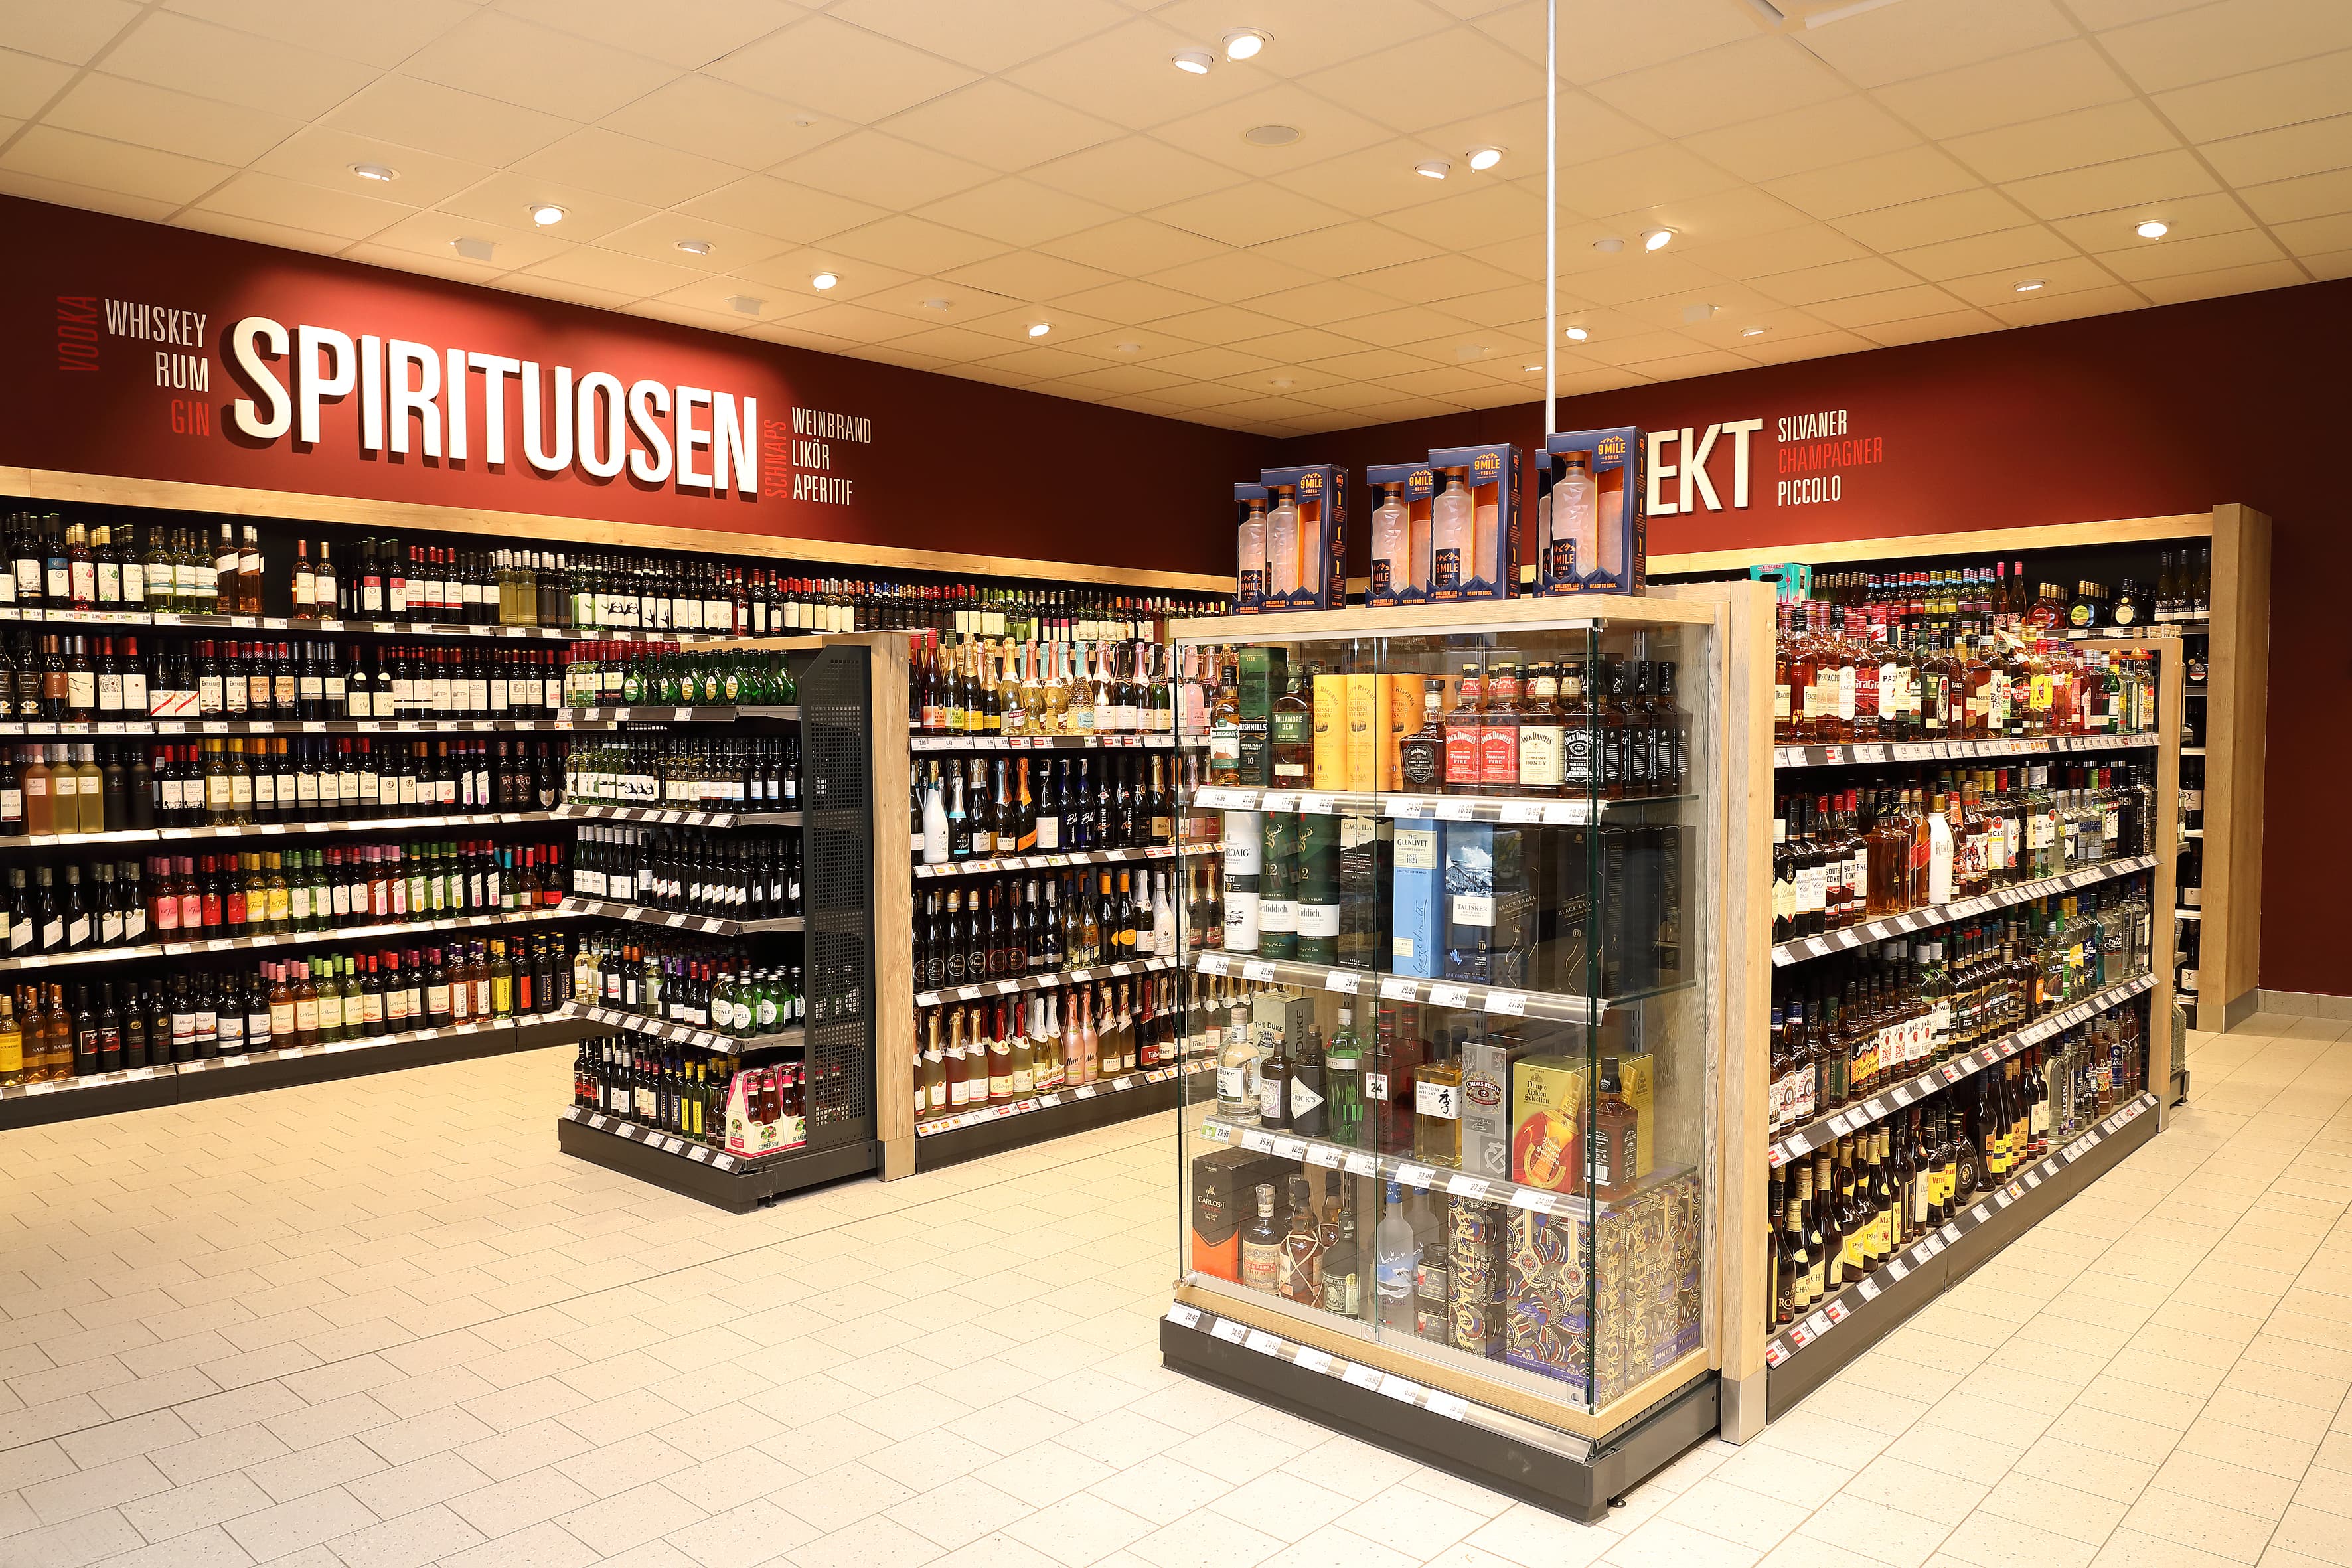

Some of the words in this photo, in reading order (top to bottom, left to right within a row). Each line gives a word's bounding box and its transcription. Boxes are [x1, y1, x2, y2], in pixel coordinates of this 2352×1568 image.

[105, 299, 206, 347] WHISKEY
[57, 296, 99, 371] VODKA
[155, 351, 209, 392] RUM
[232, 316, 758, 493] SPIRITUOSEN
[171, 399, 210, 436] GIN
[791, 407, 872, 444] WEINBRAND
[1778, 409, 1847, 442] SILVANER
[765, 420, 787, 499] SCHNAPS
[791, 438, 830, 471] LIKÖR
[1778, 437, 1883, 473] CHAMPAGNER
[1647, 418, 1763, 516] EKT
[793, 474, 853, 505] APERITIF
[1778, 475, 1841, 506] PICCOLO
[1275, 714, 1302, 723] TULLAMORE
[1446, 734, 1458, 744] JACK
[1458, 731, 1477, 744] DANIEL'S
[1481, 734, 1493, 744] JACK
[1492, 730, 1512, 744] DANIEL'S
[1521, 734, 1532, 745] JACK
[1265, 864, 1278, 876] 12
[1498, 902, 1516, 911] BLACK
[1518, 895, 1537, 904] LABEL
[1559, 907, 1577, 915] BLACK
[1261, 967, 1273, 976] 27.95
[1401, 986, 1415, 995] 29.95
[1267, 1022, 1283, 1032] DUKE
[1219, 1069, 1235, 1078] DUKE
[1368, 1074, 1386, 1083] BEEFATER
[1370, 1083, 1383, 1093] 24
[1484, 1082, 1500, 1093] REGAL
[1528, 1081, 1547, 1090] Dimple
[1524, 1094, 1549, 1104] Selection
[1528, 1089, 1547, 1097] Golden
[1217, 1130, 1229, 1138] 29.95
[758, 1141, 779, 1151] SOMERSBY
[1259, 1138, 1272, 1146] 39.95
[1417, 1173, 1433, 1182] 32.95
[1470, 1184, 1486, 1193] 27.95
[1458, 1214, 1474, 1348] POMMERY
[1185, 1312, 1198, 1323] 24.95
[1679, 1330, 1699, 1348] POMMERY
[1655, 1343, 1676, 1361] POMMERY
